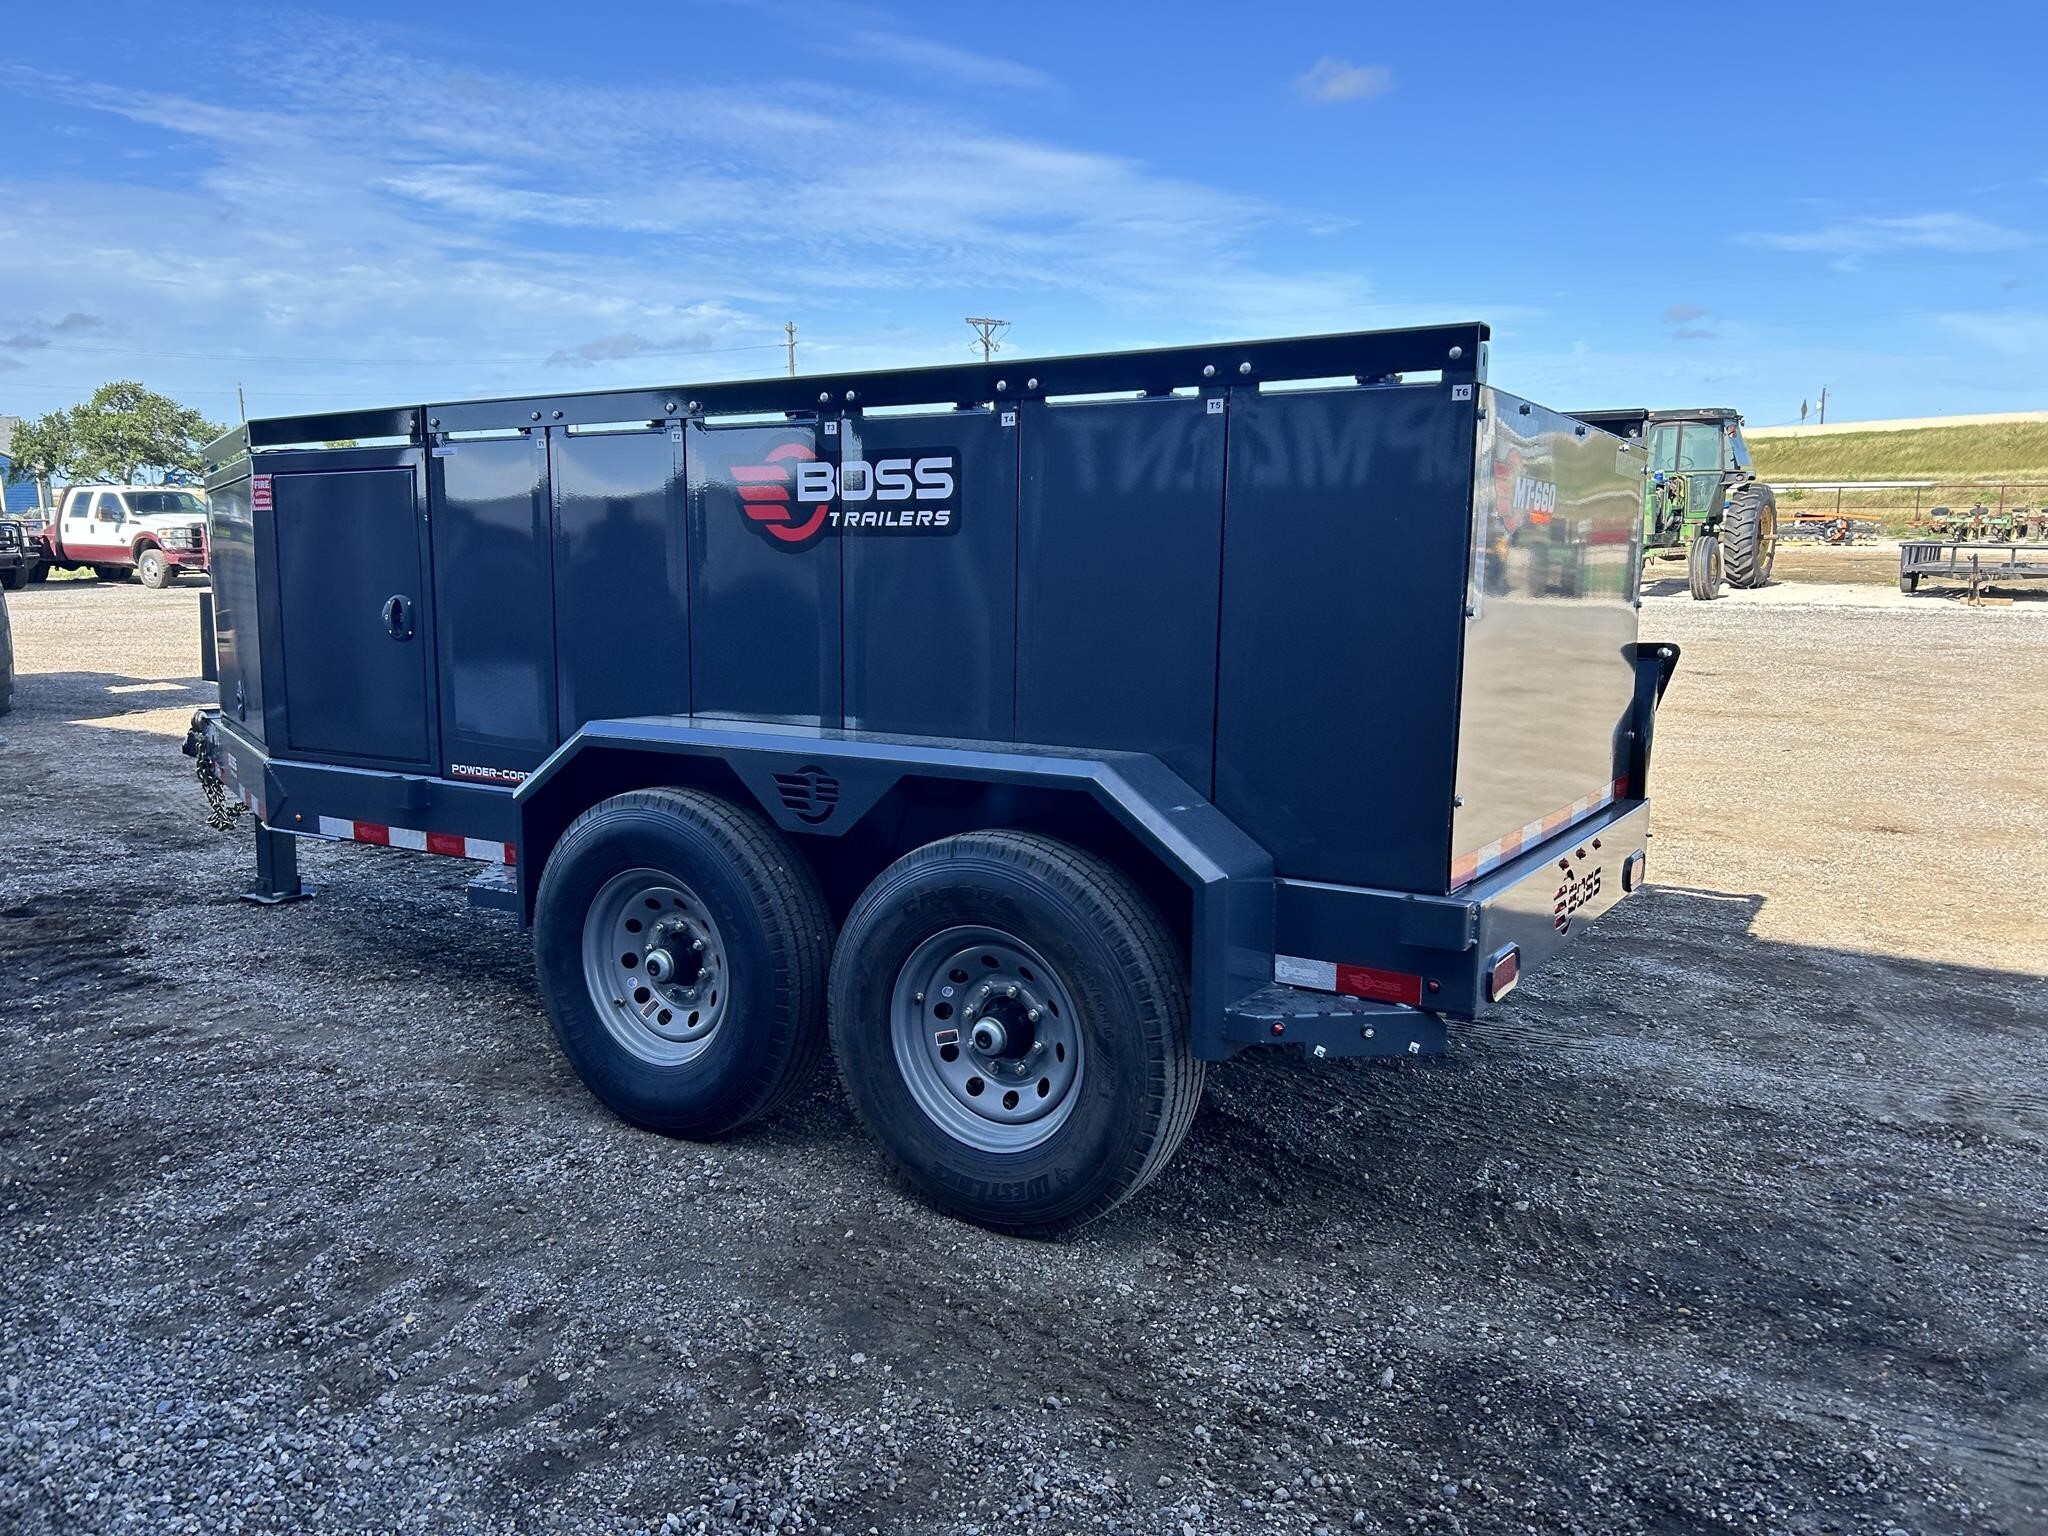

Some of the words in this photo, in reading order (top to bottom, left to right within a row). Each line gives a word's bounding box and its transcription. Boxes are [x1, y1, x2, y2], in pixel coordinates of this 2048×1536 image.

[1455, 388, 1469, 397] T6
[1209, 401, 1222, 410] T5
[1003, 415, 1015, 423] T4
[254, 480, 270, 489] FIRE
[797, 457, 954, 502] BOSS
[1512, 475, 1556, 513] MT-660
[829, 510, 951, 527] TRAILERS
[1567, 866, 1602, 914] BOSS
